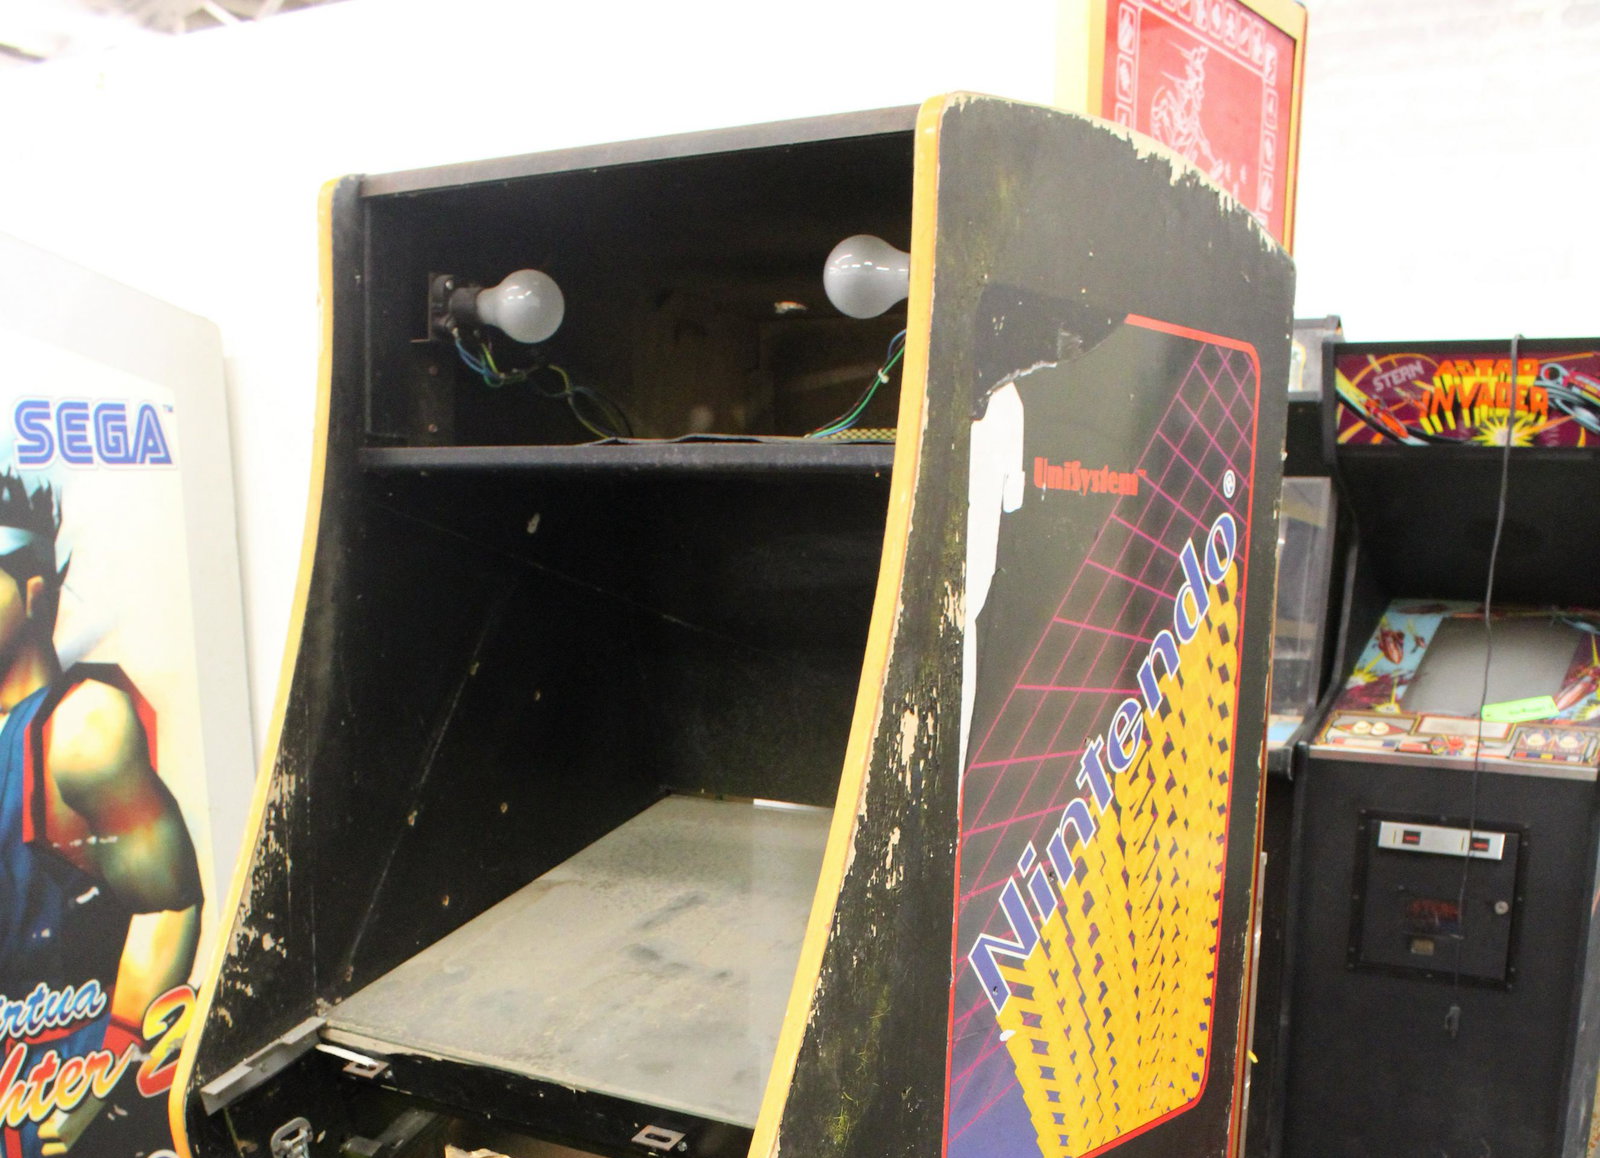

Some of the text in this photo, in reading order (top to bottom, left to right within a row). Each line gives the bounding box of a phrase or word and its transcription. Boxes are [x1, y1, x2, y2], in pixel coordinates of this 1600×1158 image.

[1372, 360, 1425, 393] STERN
[15, 400, 172, 464] SEGA
[969, 512, 1236, 1015] Nintendo
[137, 986, 197, 1097] 2
